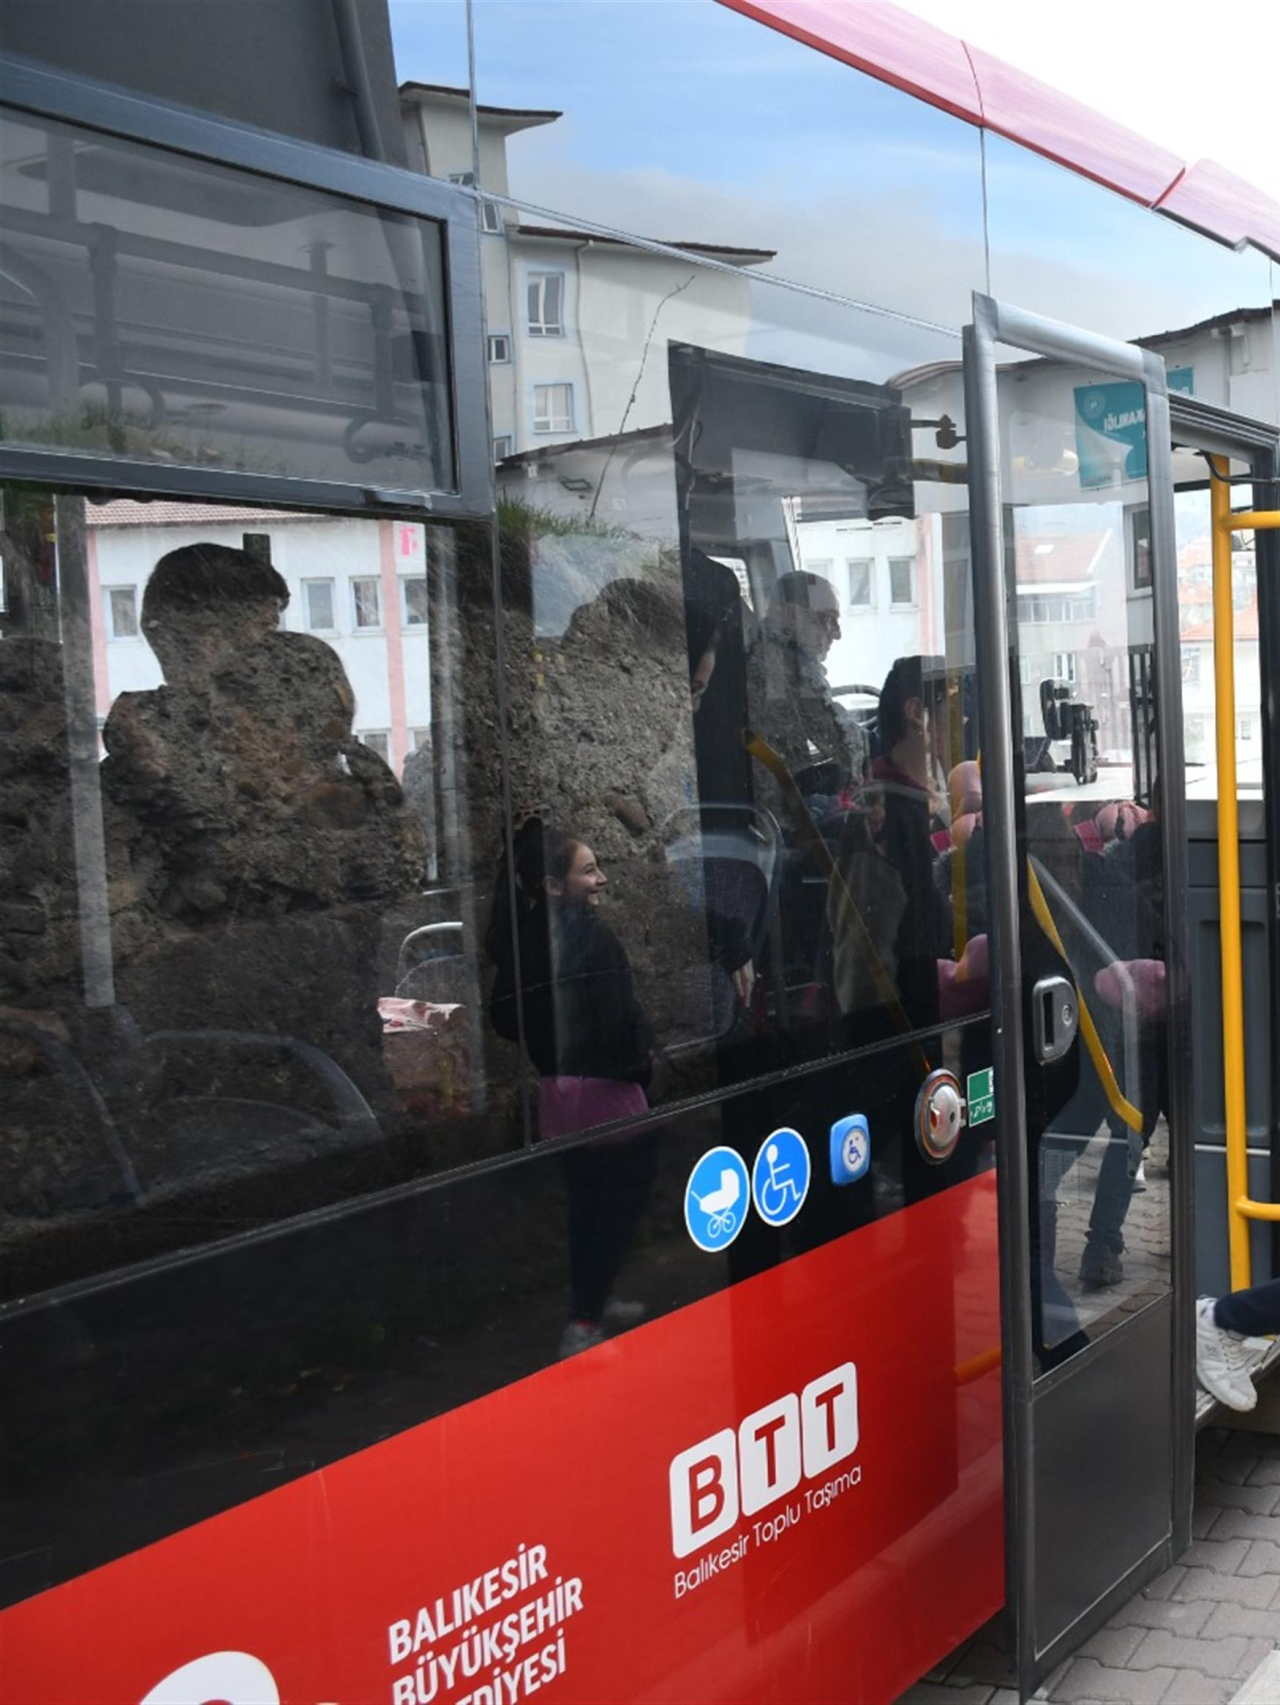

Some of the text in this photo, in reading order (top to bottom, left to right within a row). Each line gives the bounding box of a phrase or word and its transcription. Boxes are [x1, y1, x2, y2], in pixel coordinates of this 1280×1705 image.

[679, 1373, 851, 1546] BTT
[673, 1464, 863, 1600] Balıkesir Toplu Taşıma
[388, 1542, 549, 1666] BALIKESİR
[392, 1575, 584, 1705] BÜYÜKŞEHİR
[454, 1627, 567, 1705] DİYESİ
